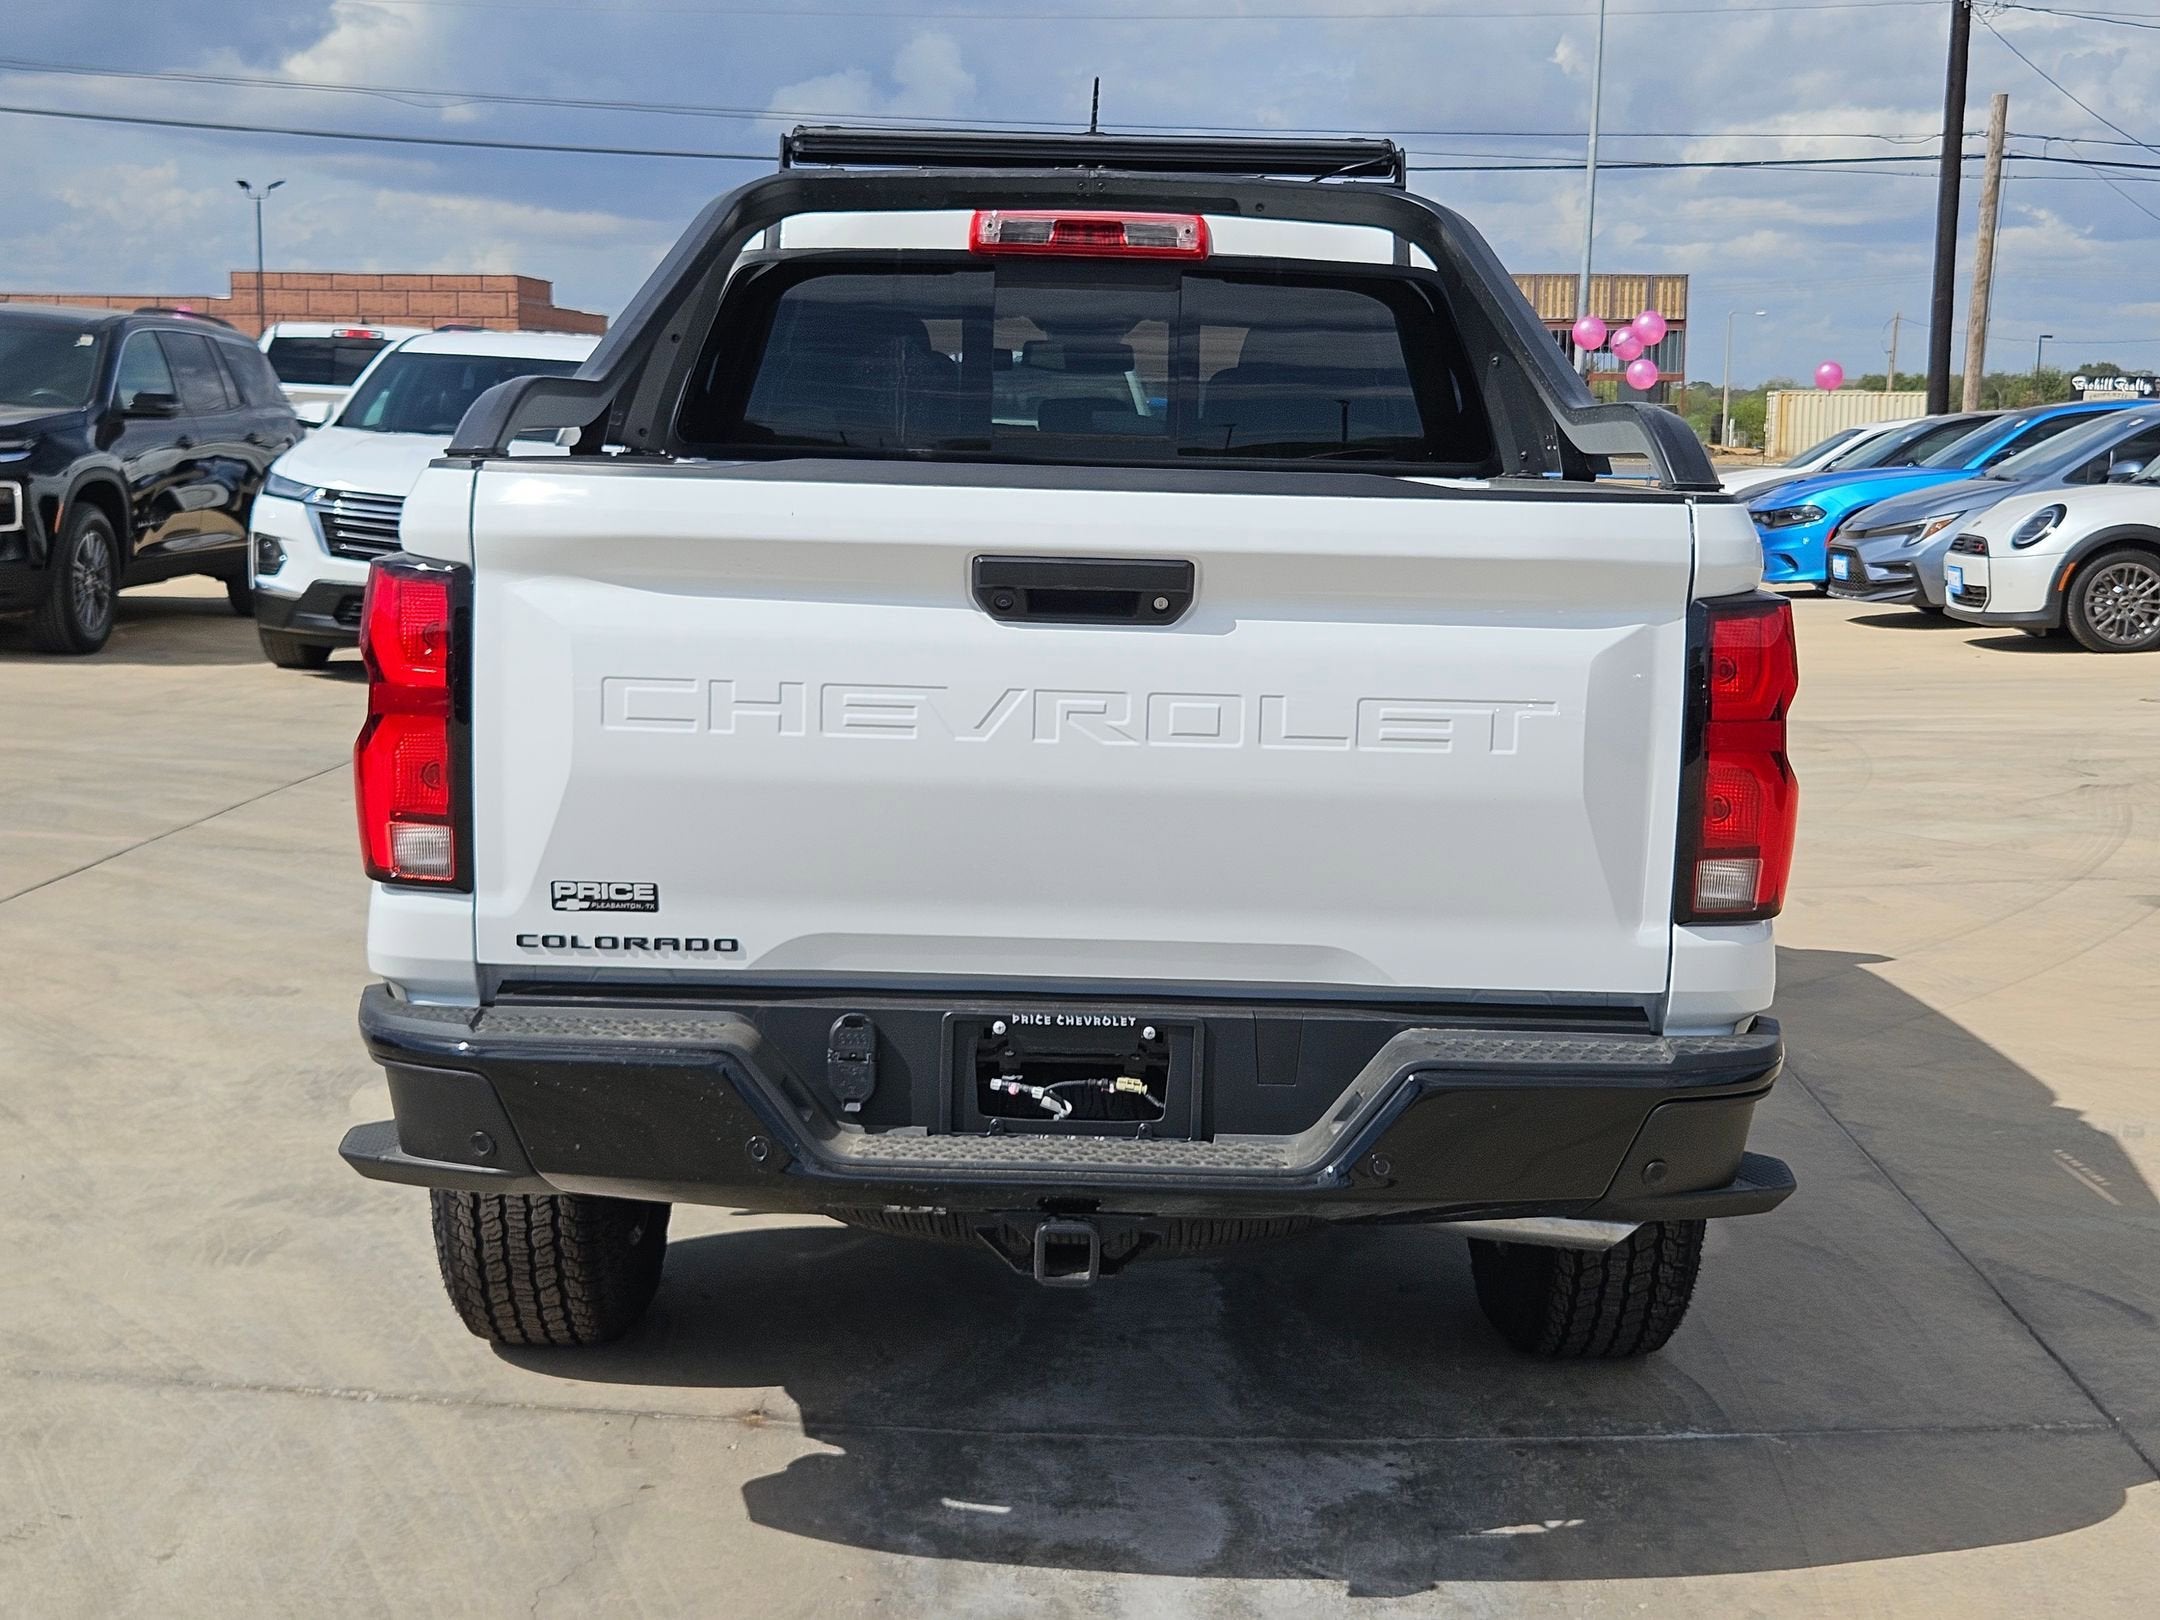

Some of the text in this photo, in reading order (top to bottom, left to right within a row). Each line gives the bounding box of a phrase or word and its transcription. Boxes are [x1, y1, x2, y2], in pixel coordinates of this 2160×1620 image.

[601, 676, 1558, 756] CHEVROLET
[554, 882, 655, 901] PRICE
[516, 934, 739, 952] COLORADO
[1012, 1013, 1136, 1027] PRICE CHEVROLET
